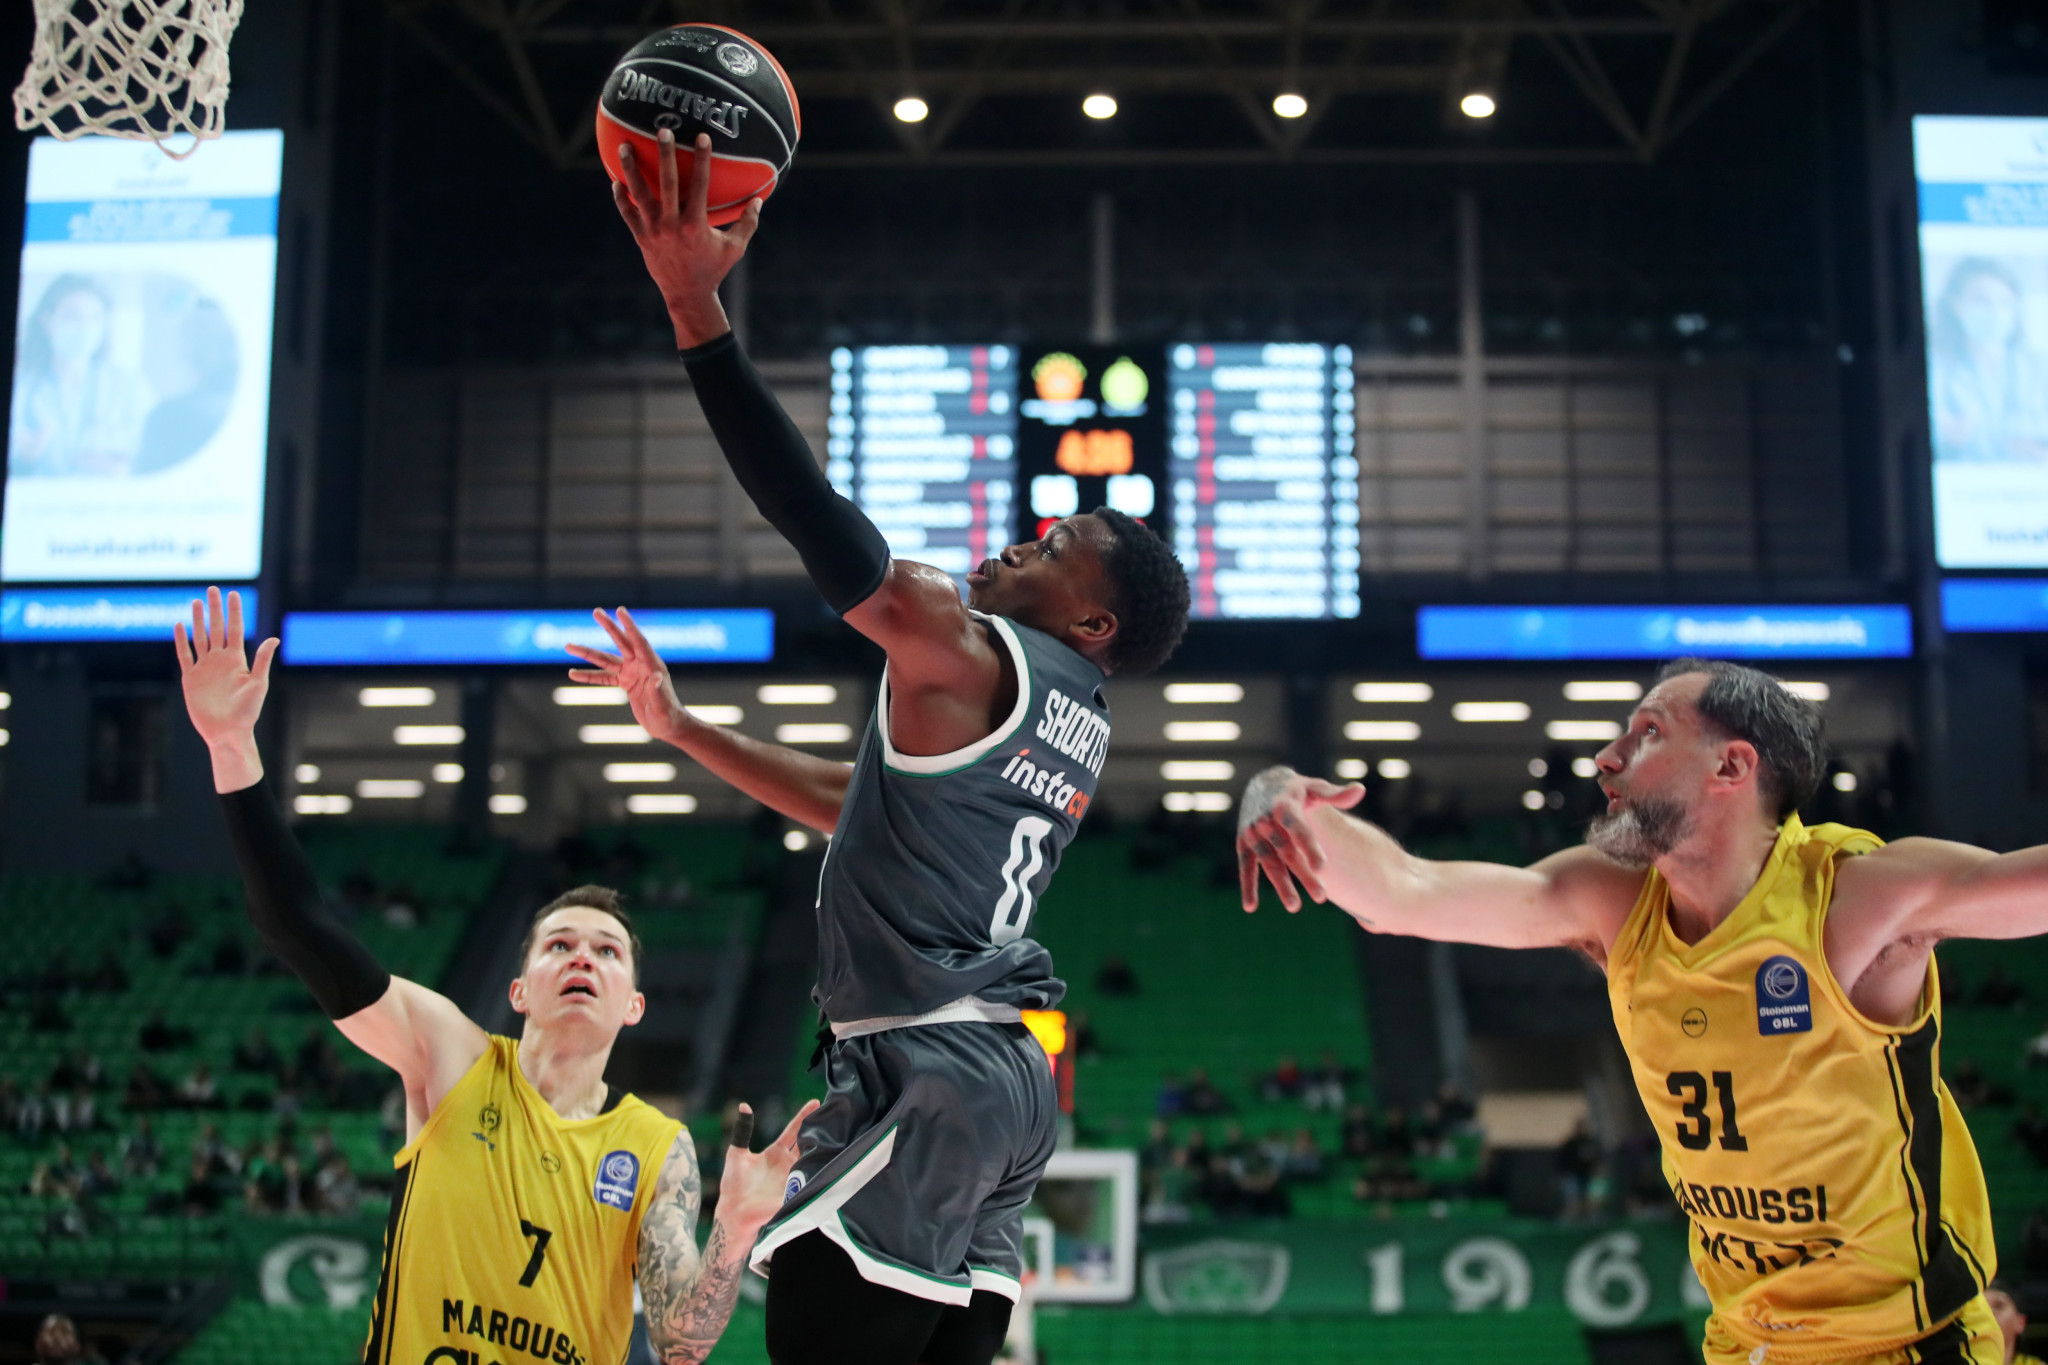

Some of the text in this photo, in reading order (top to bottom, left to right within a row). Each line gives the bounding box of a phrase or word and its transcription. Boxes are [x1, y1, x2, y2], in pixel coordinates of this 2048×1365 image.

[617, 67, 748, 139] SPALDING
[990, 816, 1053, 948] 0
[1772, 1017, 1798, 1030] GBL
[1665, 1071, 1748, 1152] 31
[1674, 1178, 1827, 1224] AROUSSI
[517, 1219, 553, 1287] 7
